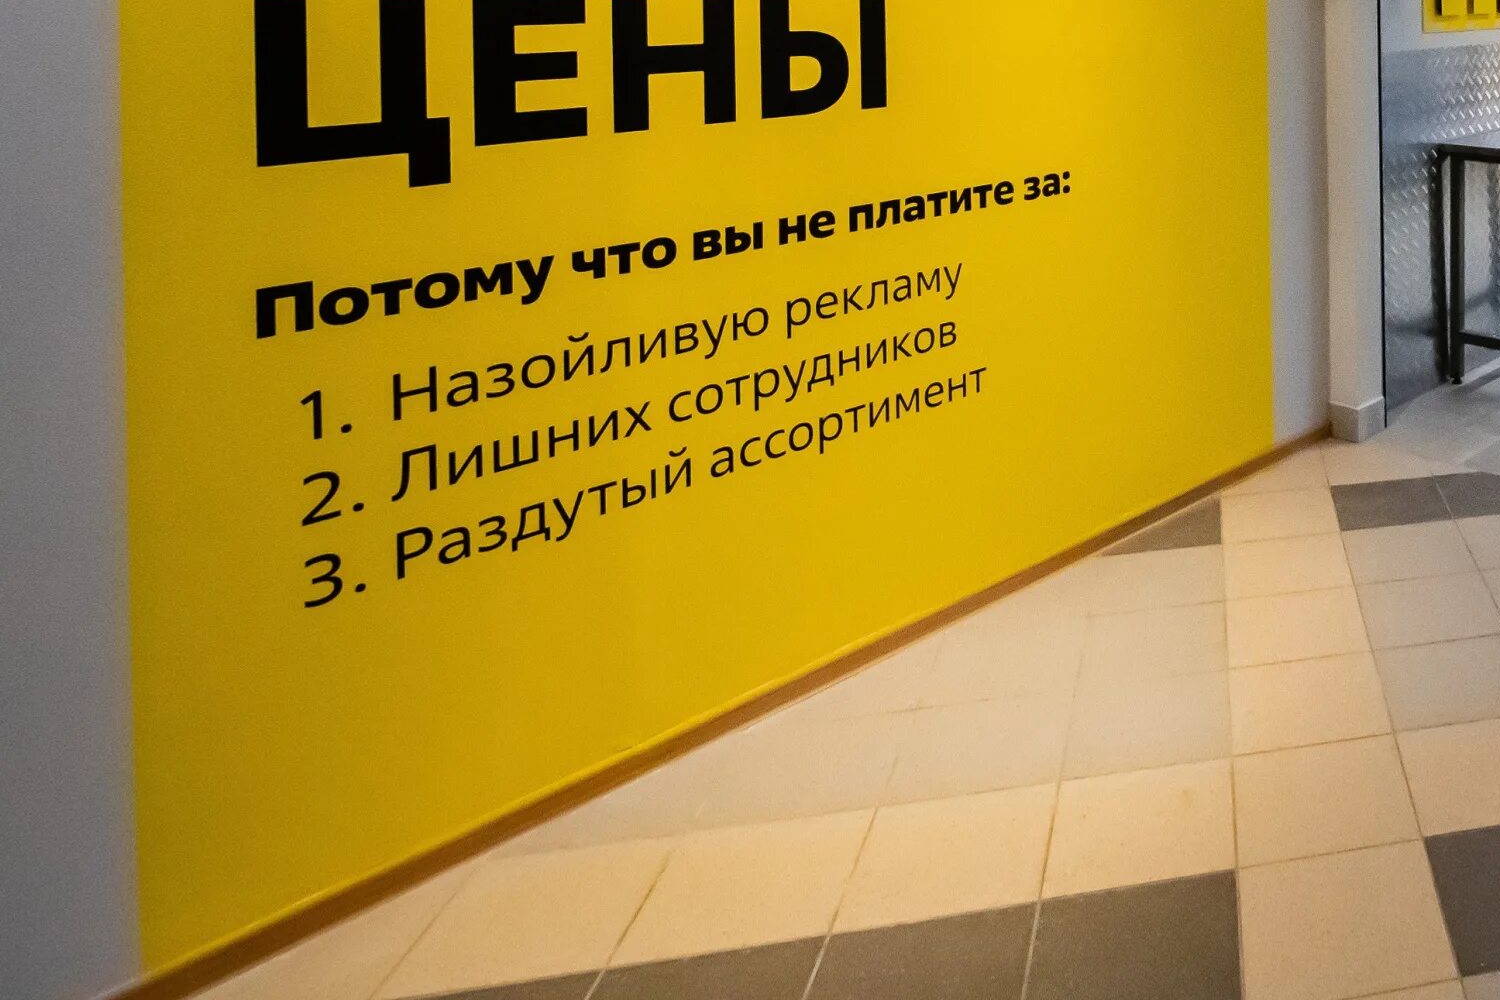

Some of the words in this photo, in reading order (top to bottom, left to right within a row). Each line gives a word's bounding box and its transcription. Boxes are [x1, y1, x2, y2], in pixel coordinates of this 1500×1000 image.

[255, 256, 554, 339] Потому
[571, 237, 677, 279] что
[693, 221, 763, 261] вы
[779, 210, 836, 245] не
[849, 181, 1014, 233] платите
[1024, 171, 1071, 201] за:
[300, 390, 353, 440] 1.
[393, 307, 770, 421] Назойливую
[786, 259, 964, 339] рекламу
[302, 471, 365, 527] 2.
[391, 402, 651, 502] Лишних
[668, 318, 959, 422] сотрудников
[304, 553, 367, 608] 3.
[396, 447, 692, 580] Раздутый
[710, 364, 988, 478] ассортимент
